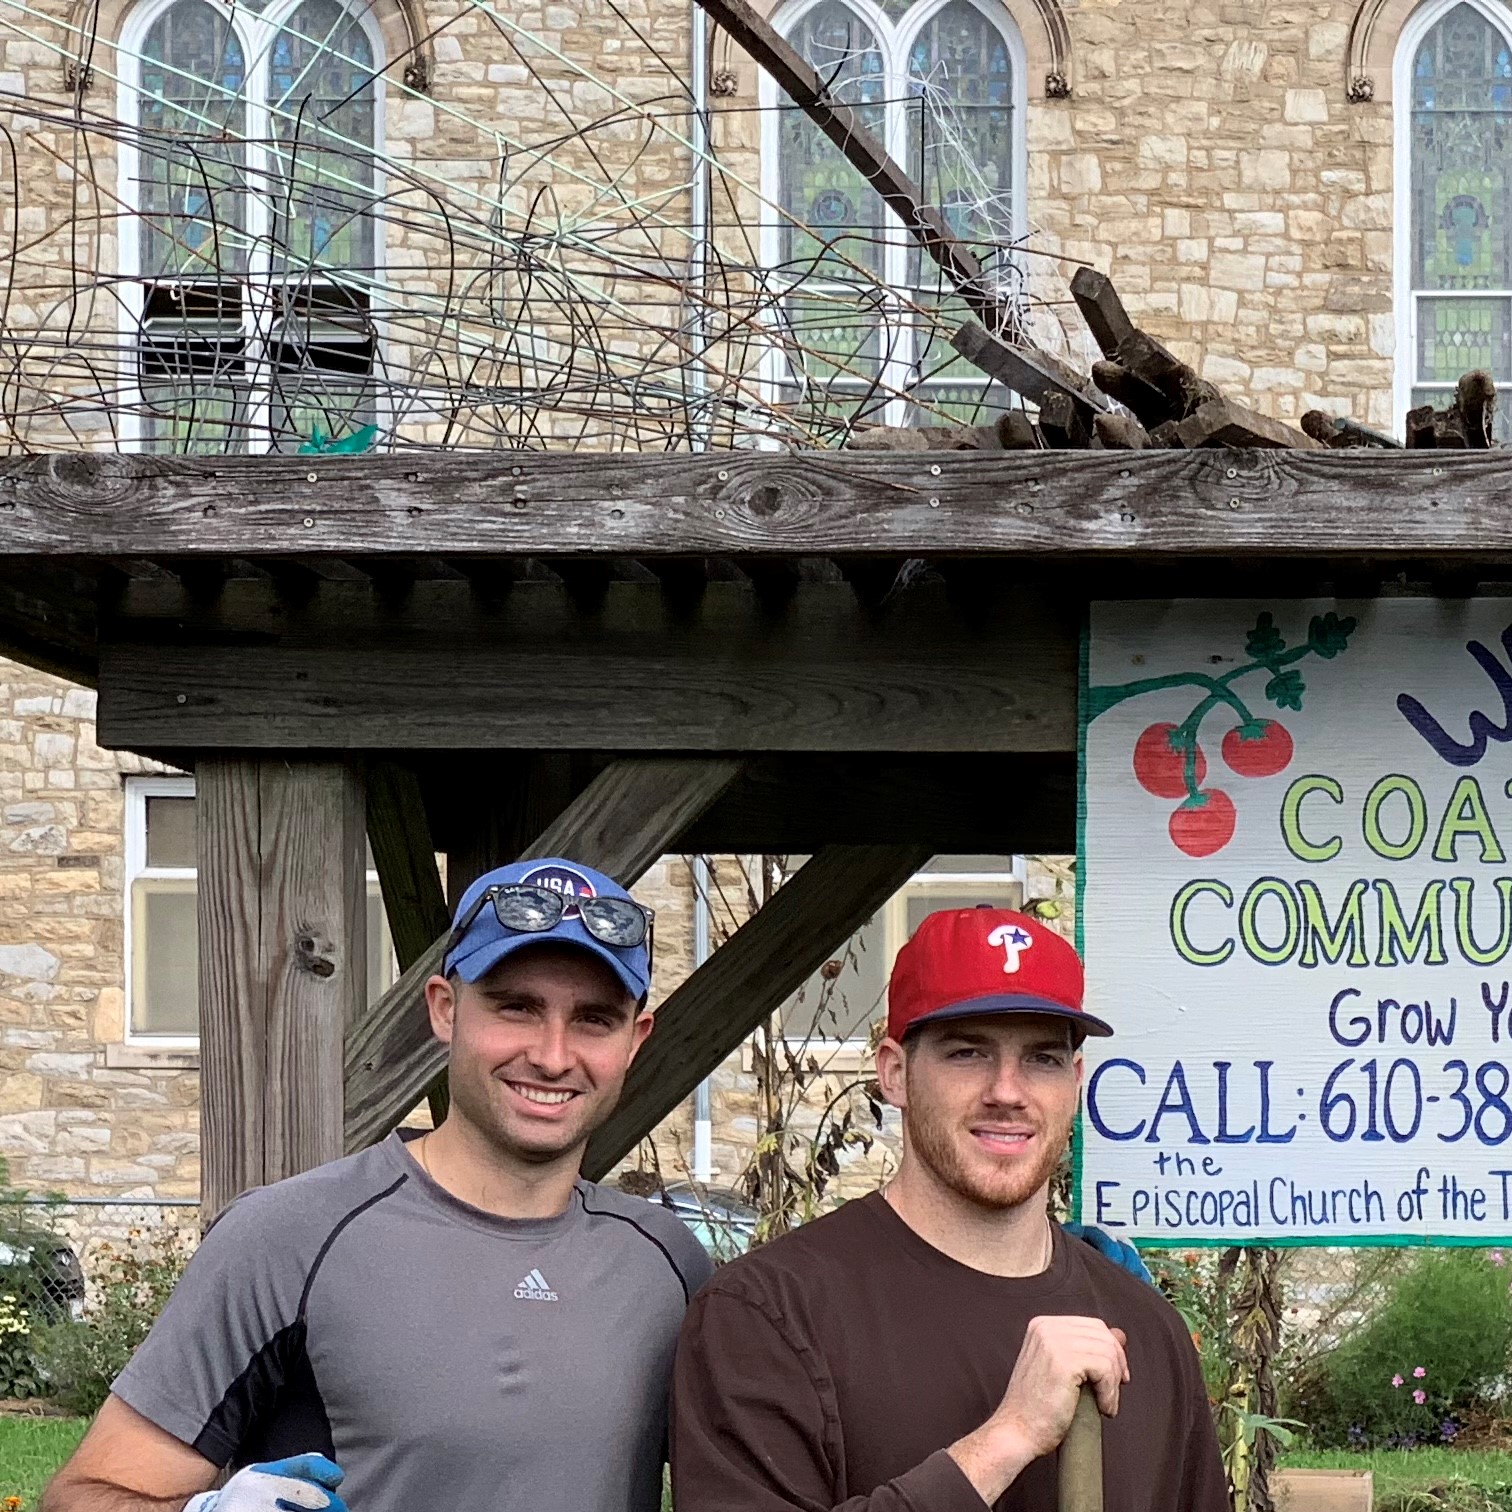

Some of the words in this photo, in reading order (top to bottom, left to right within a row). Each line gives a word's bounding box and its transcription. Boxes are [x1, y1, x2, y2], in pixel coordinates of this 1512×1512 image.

[536, 877, 575, 898] USA
[1327, 986, 1458, 1047] Grow
[1153, 1151, 1223, 1177] the
[1095, 1179, 1260, 1229] Episcopal
[1269, 1175, 1386, 1227] Church
[1397, 1166, 1431, 1224] of
[1437, 1174, 1487, 1224] the
[513, 1287, 559, 1302] adidas
